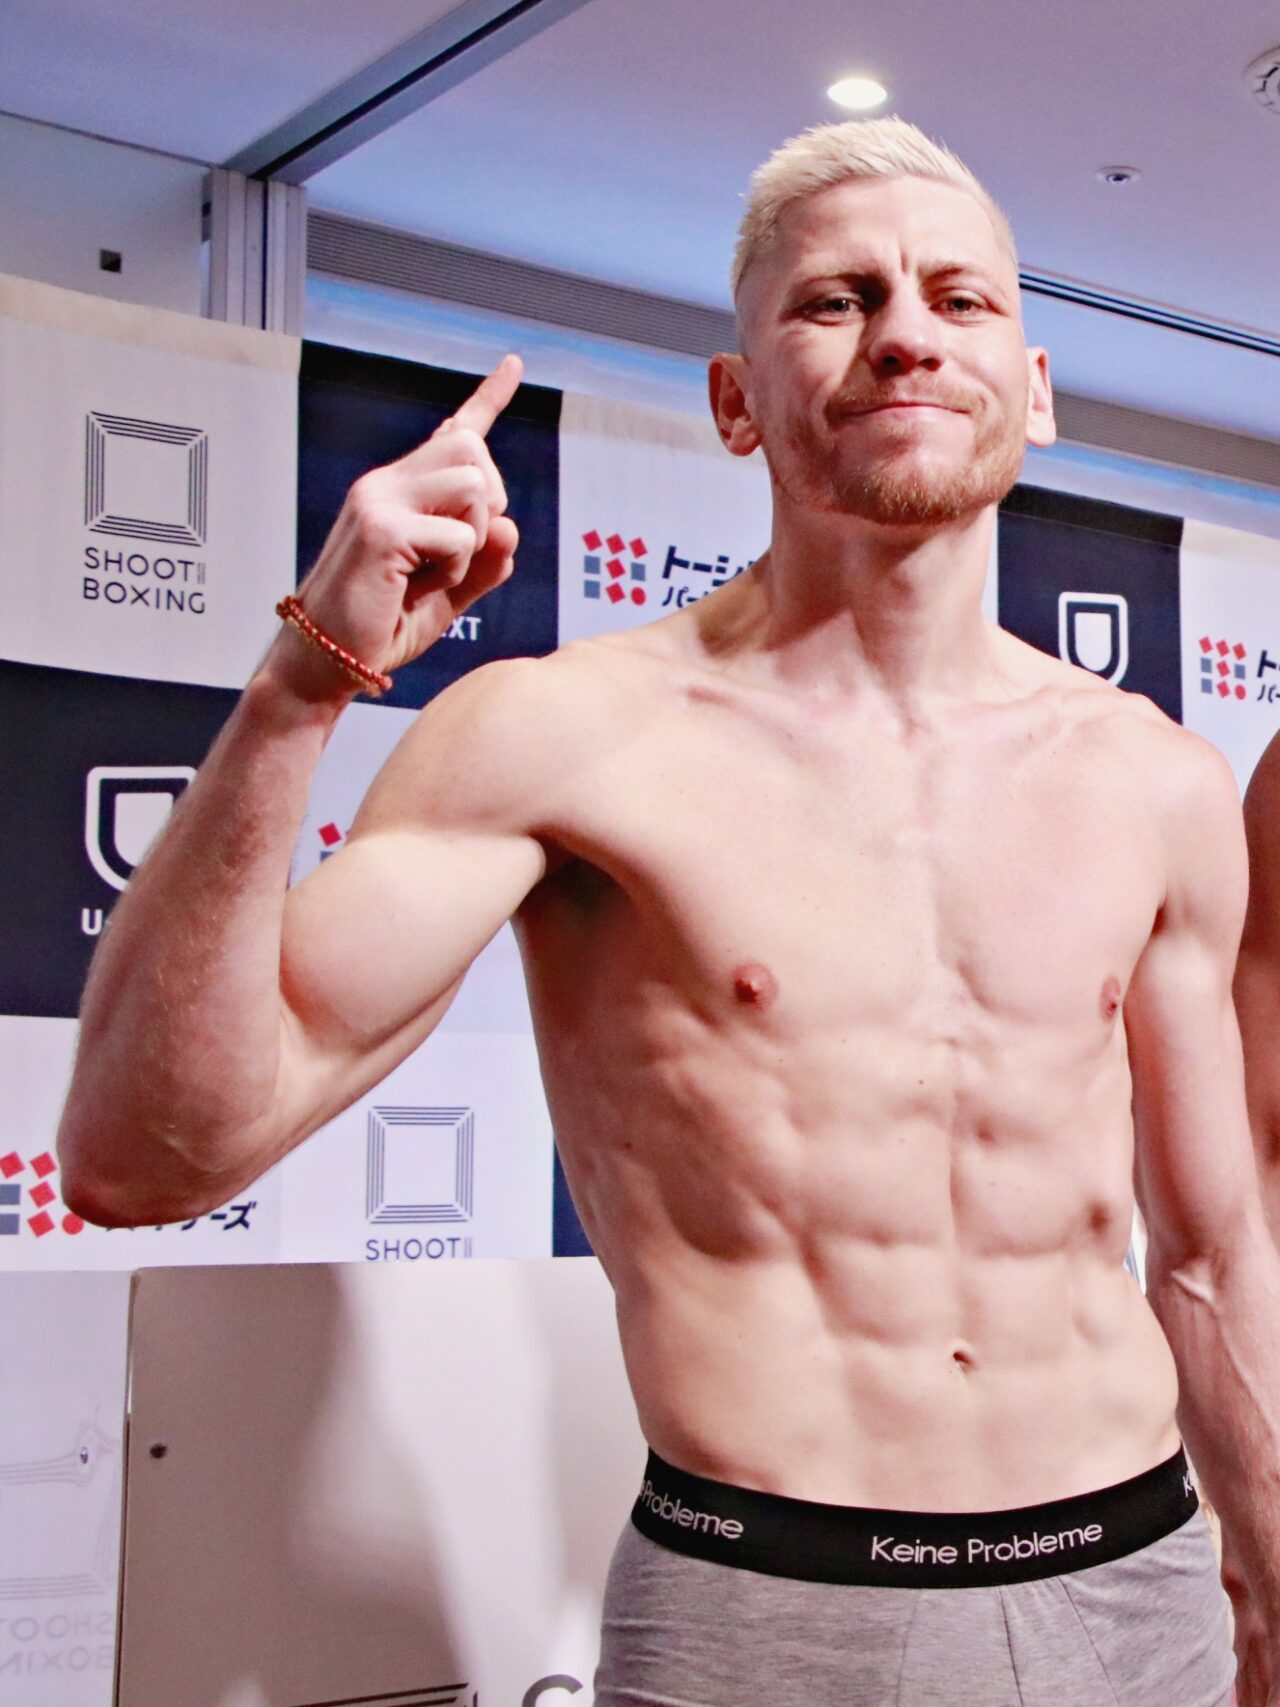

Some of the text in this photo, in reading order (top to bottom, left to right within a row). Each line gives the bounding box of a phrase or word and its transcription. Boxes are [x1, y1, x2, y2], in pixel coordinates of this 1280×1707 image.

[84, 547, 195, 582] SHOOT
[661, 545, 756, 588] トーシ
[83, 577, 206, 614] BOXING
[366, 1238, 461, 1260] SHOOT
[871, 1524, 1103, 1564] Keine Probleme
